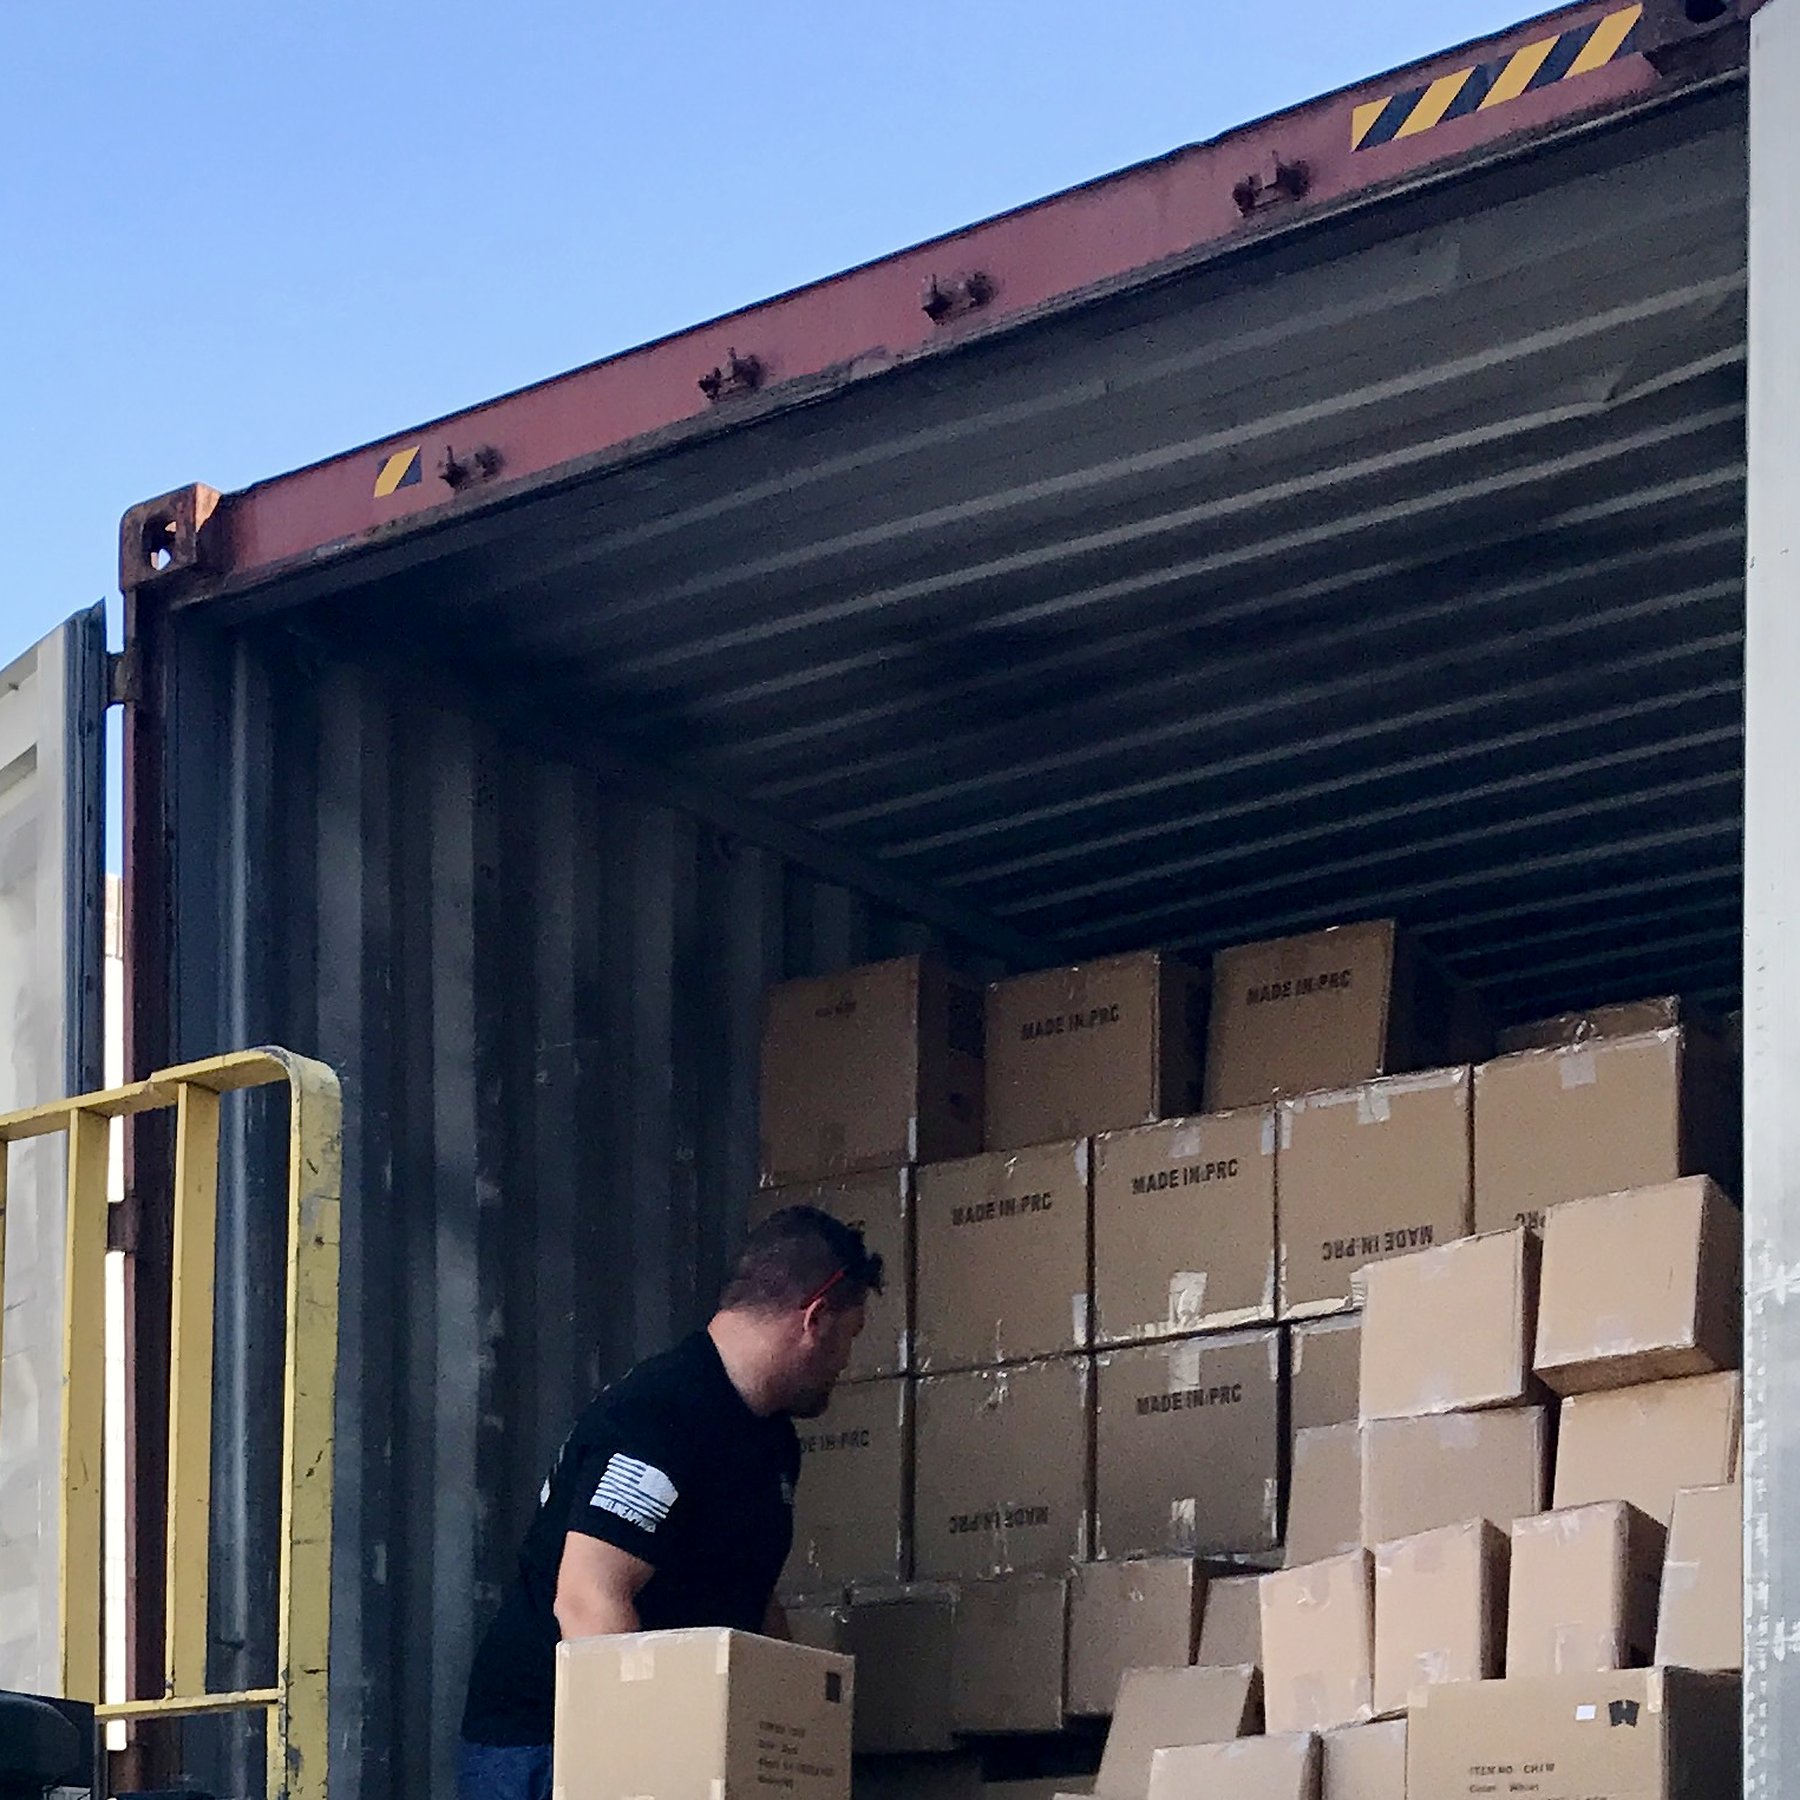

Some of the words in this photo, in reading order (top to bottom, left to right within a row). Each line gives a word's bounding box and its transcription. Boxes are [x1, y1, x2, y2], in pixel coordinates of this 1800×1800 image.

[1132, 1169, 1179, 1195] MADE
[952, 1201, 995, 1226] MADE
[1384, 1225, 1433, 1252] MADE
[1137, 1392, 1182, 1415] MADE
